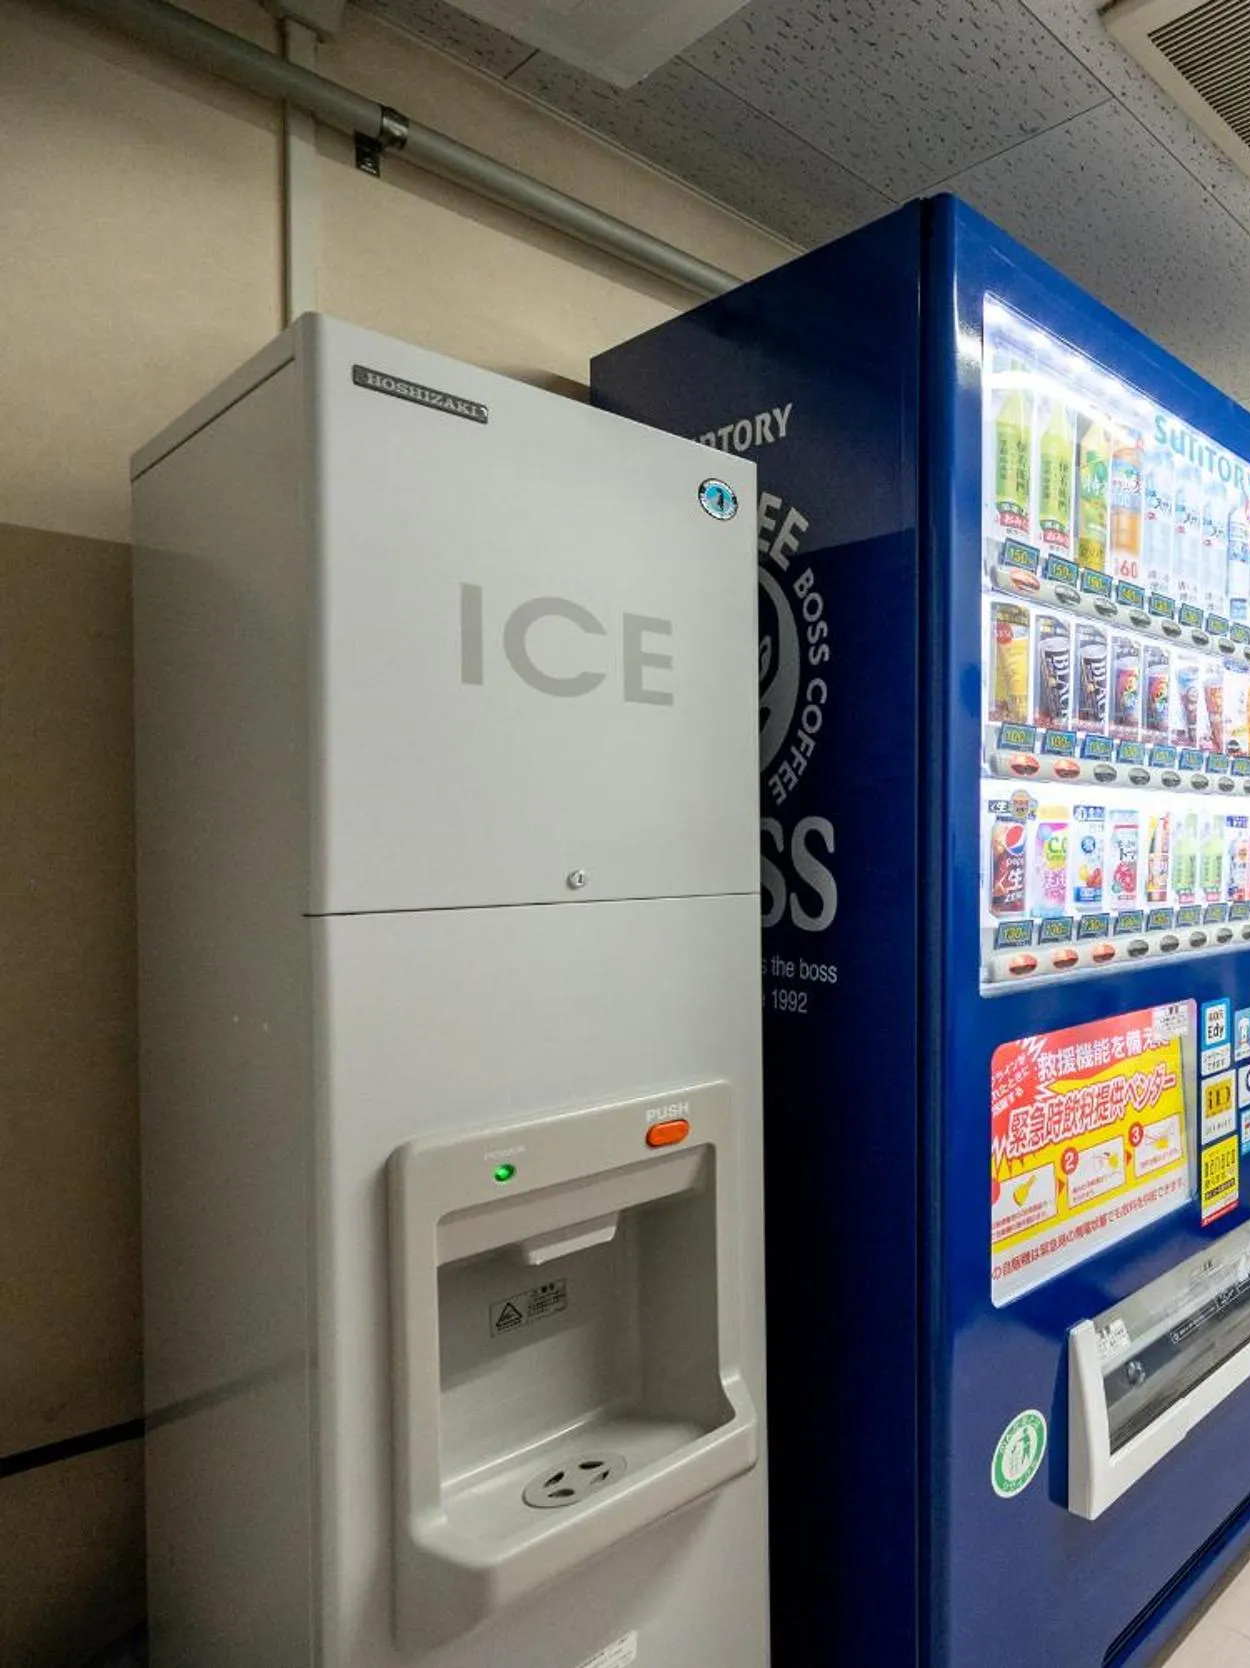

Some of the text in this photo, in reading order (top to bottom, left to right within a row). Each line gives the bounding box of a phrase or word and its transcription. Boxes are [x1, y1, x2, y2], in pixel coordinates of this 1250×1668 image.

[366, 372, 478, 417] HOSHIZAKI
[459, 581, 675, 708] ICE
[767, 567, 831, 805] BOSS COFFEE
[771, 954, 795, 979] the
[799, 957, 838, 984] boss
[771, 987, 808, 1013] 1992
[1207, 1022, 1224, 1039] Edy
[645, 1101, 690, 1122] PUSH
[1208, 1086, 1231, 1110] iD
